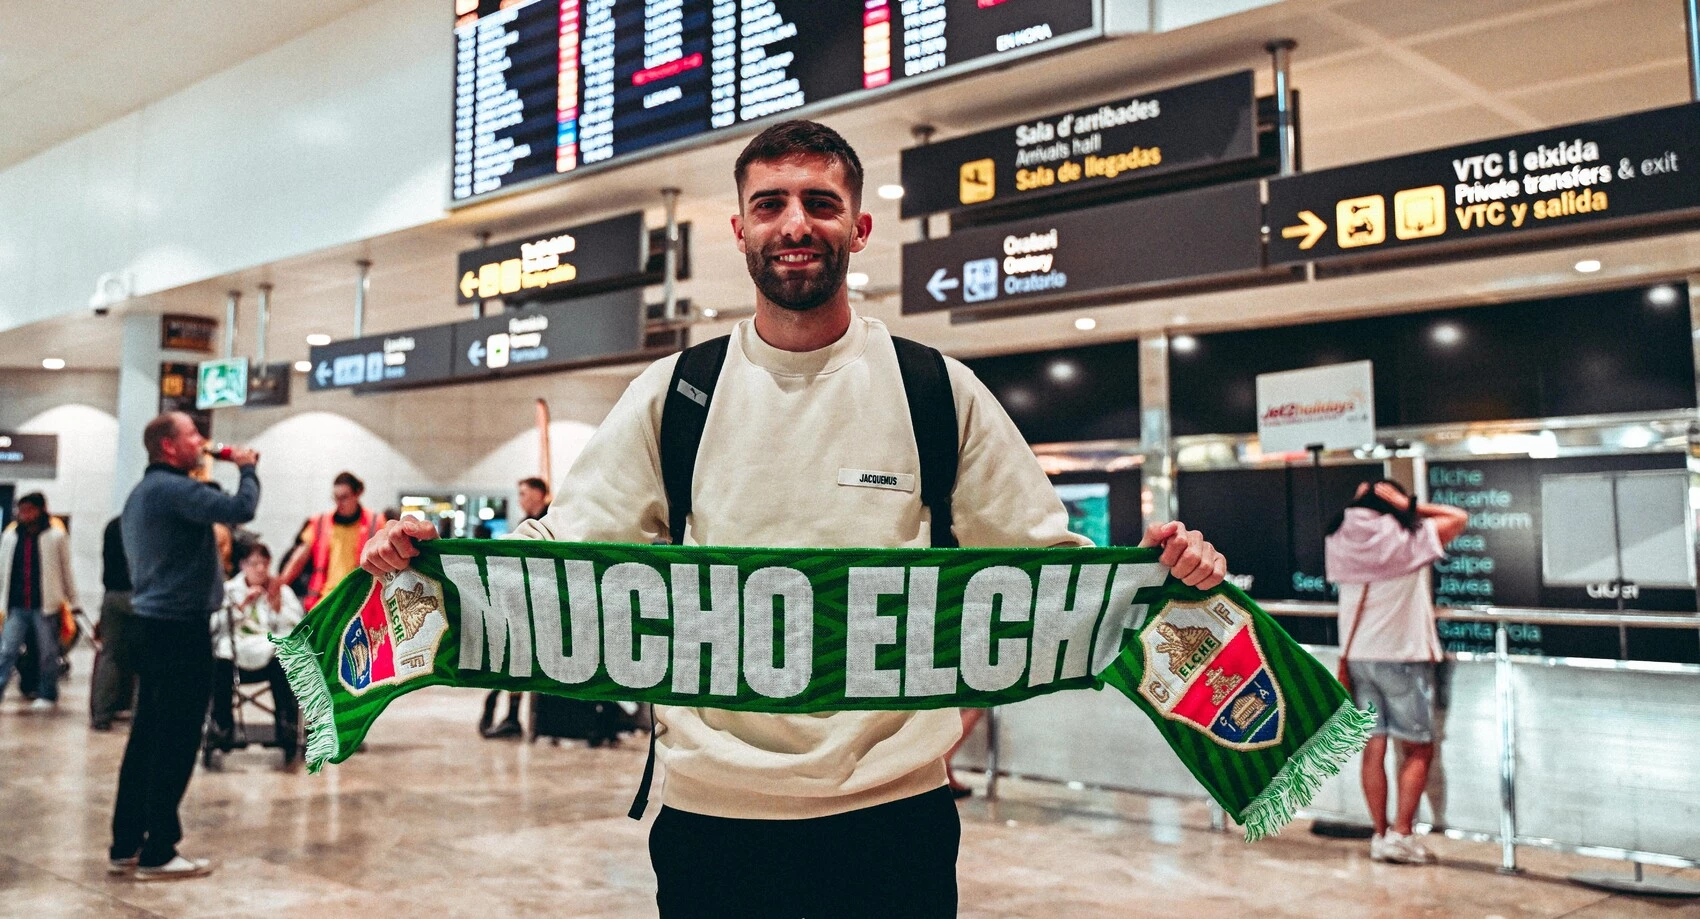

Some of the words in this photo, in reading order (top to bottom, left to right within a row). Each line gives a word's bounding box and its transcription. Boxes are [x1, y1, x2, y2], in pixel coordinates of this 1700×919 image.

[1015, 121, 1054, 147] Sala
[1057, 99, 1160, 138] d'arribades
[1015, 141, 1070, 168] Arrivals
[1072, 133, 1101, 156] hall
[1015, 165, 1054, 191] Sala
[1057, 160, 1081, 183] de
[1085, 146, 1162, 178] llegadas
[1452, 153, 1503, 182] VTC
[1523, 138, 1599, 171] eixida
[1454, 178, 1520, 206] Private
[1523, 165, 1612, 195] transfers
[1617, 157, 1635, 180] &
[1640, 150, 1679, 176] exit
[1455, 201, 1506, 230] VTC
[1511, 202, 1528, 228] y
[1533, 188, 1608, 220] salida
[859, 474, 897, 485] JACQUEMUS
[1429, 466, 1484, 487] Elche
[1432, 487, 1513, 508] Alicante
[1292, 571, 1326, 592] See
[1434, 556, 1495, 576] Calpe
[390, 598, 405, 642] ELCHE
[440, 554, 814, 699] MUCHO
[1437, 619, 1494, 639] Santa
[1179, 637, 1216, 677] ELCHE
